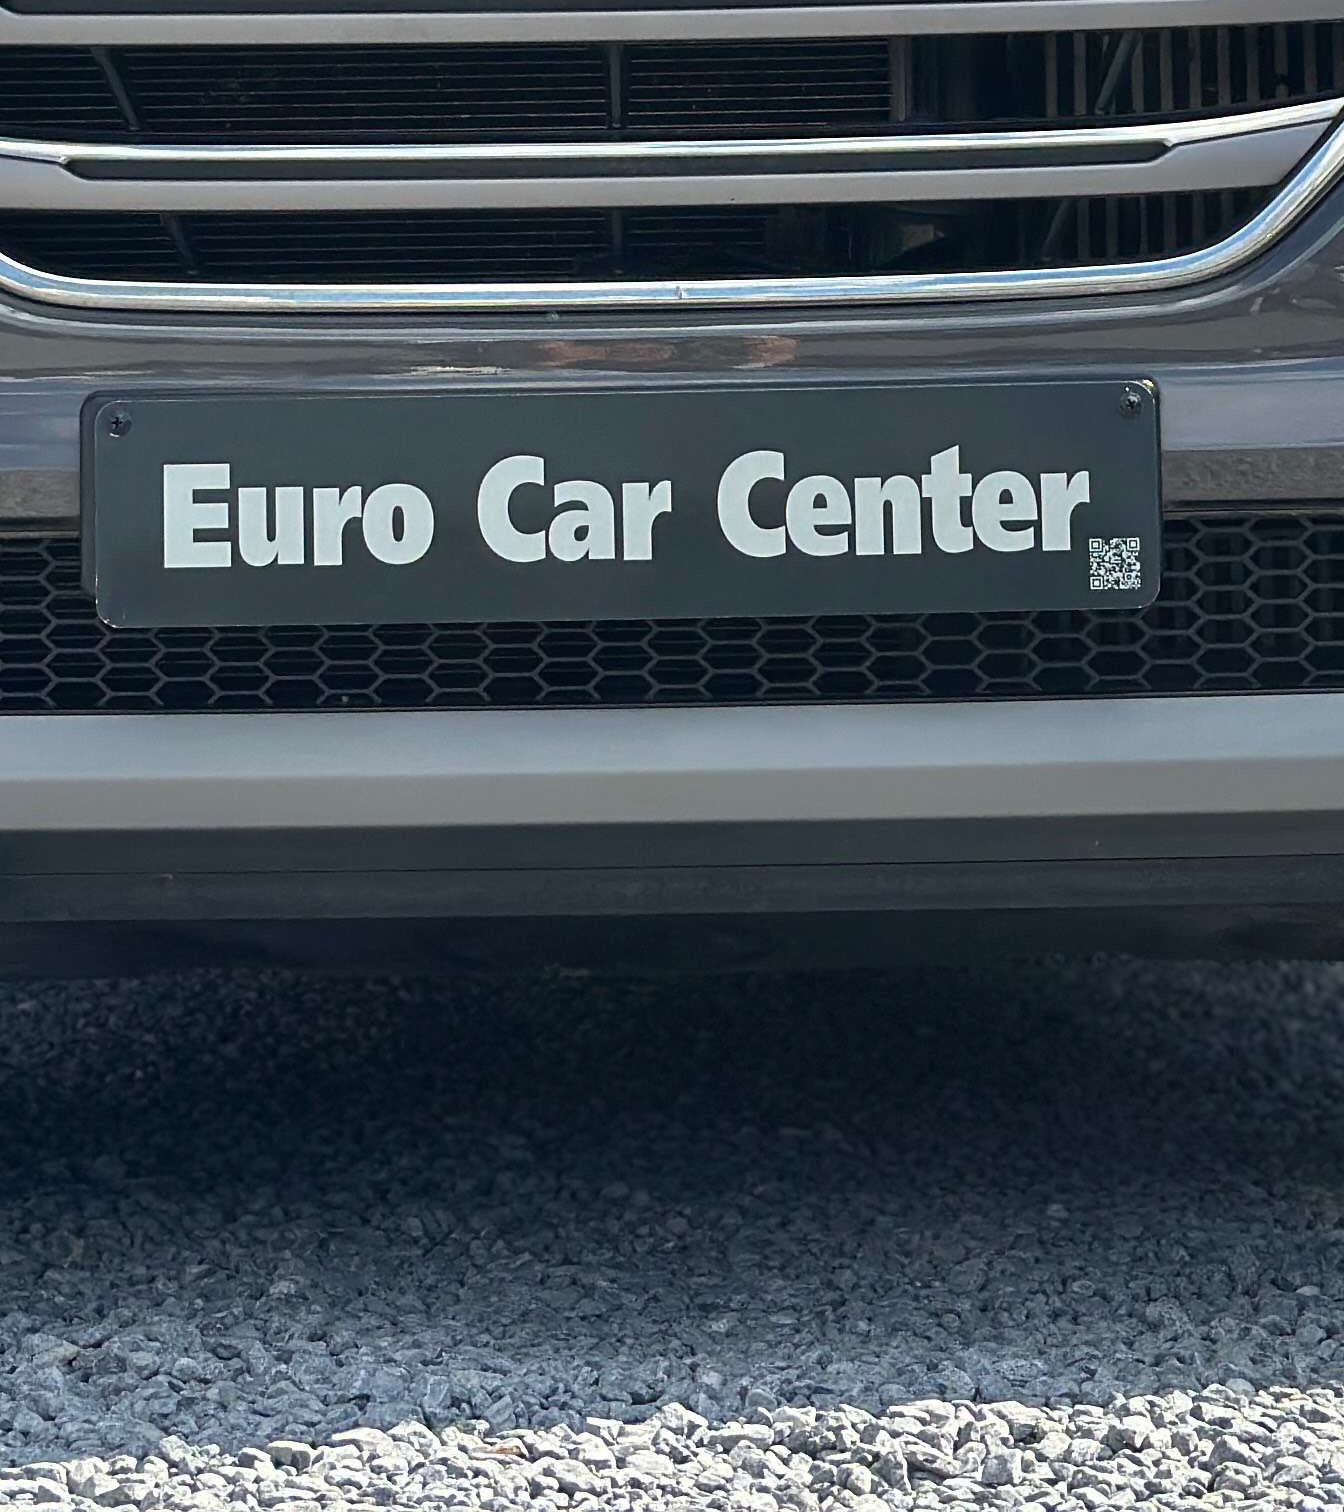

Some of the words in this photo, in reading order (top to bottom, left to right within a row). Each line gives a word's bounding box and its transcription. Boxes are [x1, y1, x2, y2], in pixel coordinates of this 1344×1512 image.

[163, 463, 435, 569] Euro
[477, 455, 672, 563] Car
[717, 444, 1091, 558] Center
